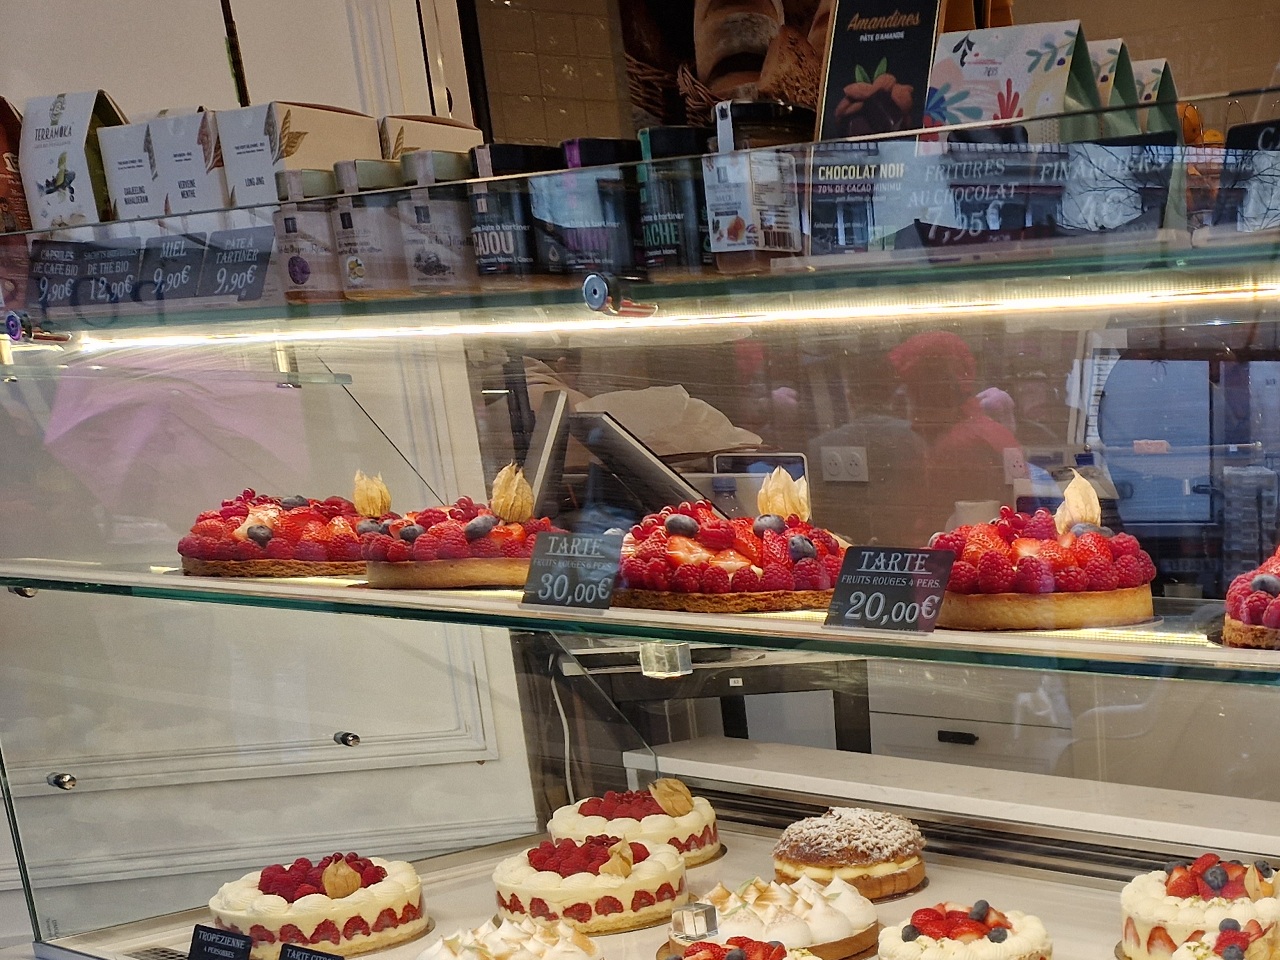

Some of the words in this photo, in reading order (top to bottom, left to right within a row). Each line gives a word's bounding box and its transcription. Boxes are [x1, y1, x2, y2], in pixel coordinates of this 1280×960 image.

[847, 10, 920, 31] Amandines
[818, 165, 877, 180] CHOCOLAT
[925, 158, 1005, 181] FRITURES
[934, 182, 1019, 204] CHOCOLAT
[160, 240, 187, 258] MIEL
[216, 248, 259, 264] TARTINER
[87, 263, 98, 275] DE
[115, 261, 129, 273] BIO
[38, 276, 75, 301] 9,90€
[89, 274, 134, 302] 12,90€
[151, 265, 191, 294] 9,90€
[214, 264, 258, 294] 9,90€
[548, 536, 602, 555] TARTE
[861, 551, 930, 572] TARTE
[538, 573, 613, 605] 30,00€
[841, 574, 871, 584] FRUITS
[872, 576, 907, 587] ROUGES
[916, 579, 941, 588] PERS.
[845, 591, 940, 626] 20,00€
[208, 946, 235, 959] PERSONNES
